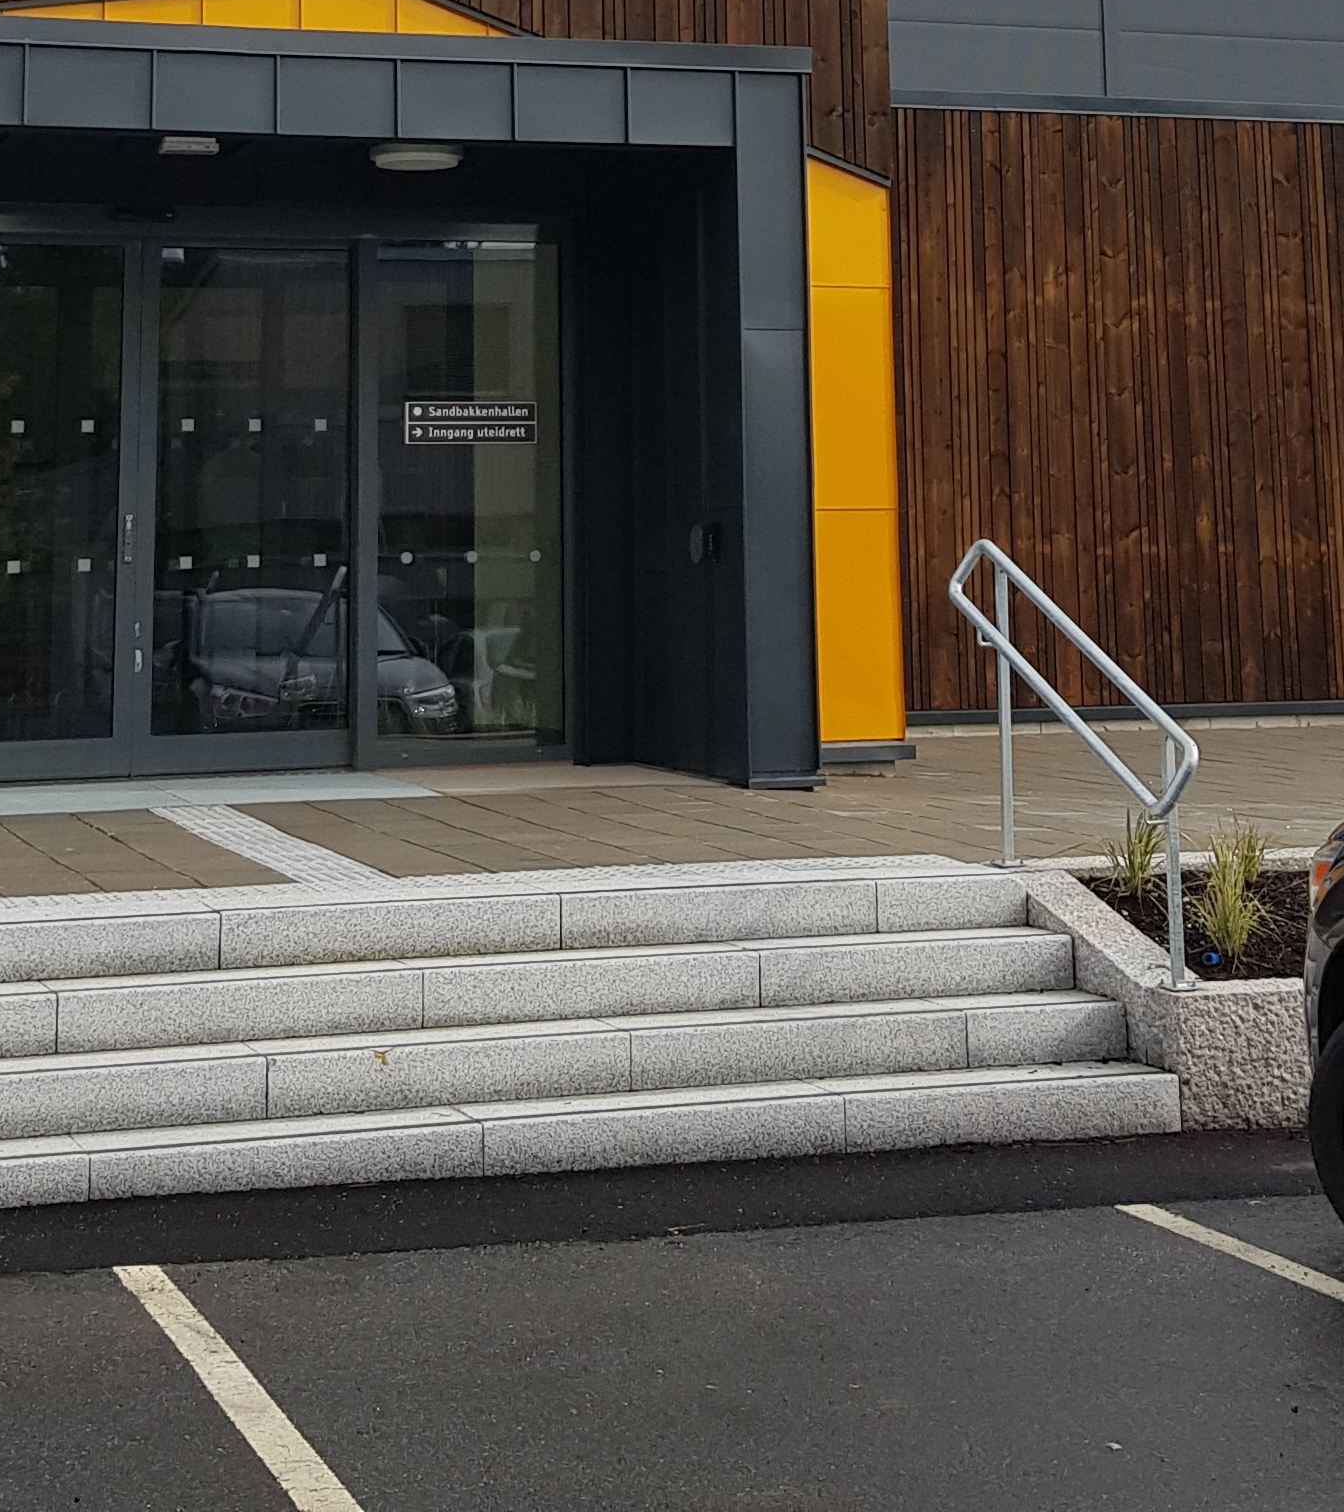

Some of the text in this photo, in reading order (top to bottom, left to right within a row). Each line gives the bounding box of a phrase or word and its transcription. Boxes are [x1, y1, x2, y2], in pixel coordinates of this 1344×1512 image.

[428, 405, 529, 417] Sandbakkenhallen
[428, 426, 526, 440] Inngang uteidrett
